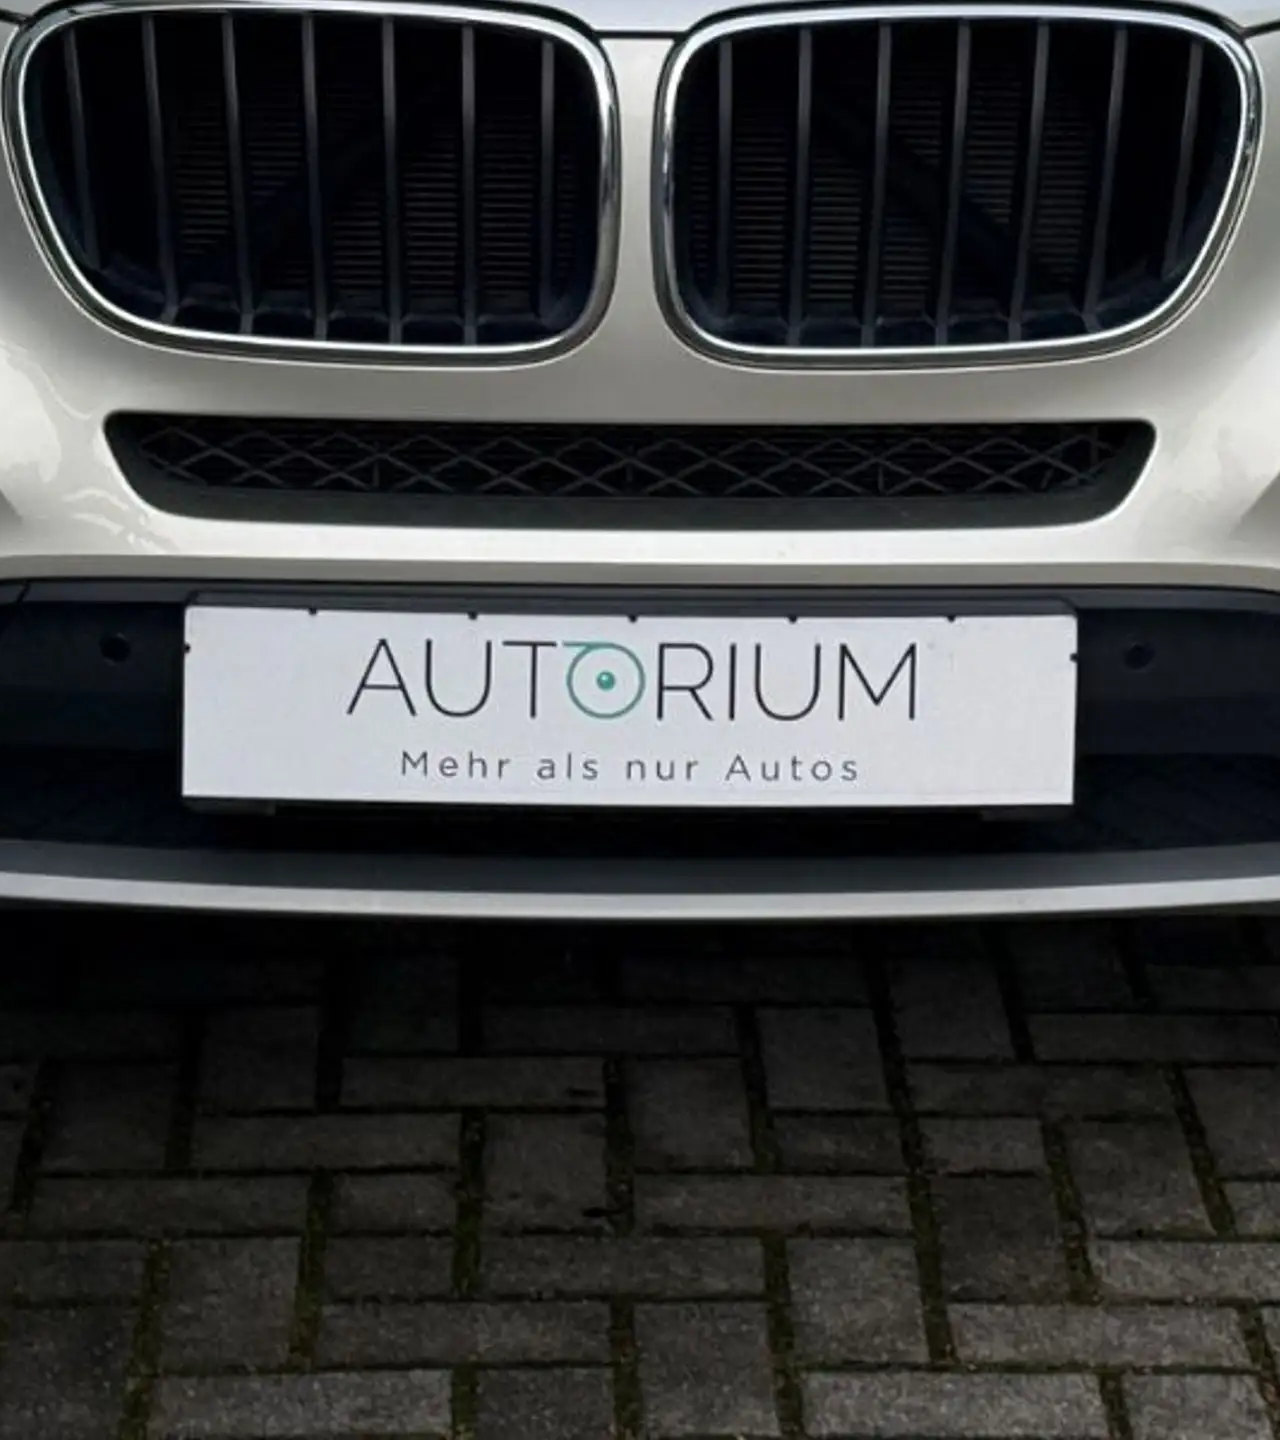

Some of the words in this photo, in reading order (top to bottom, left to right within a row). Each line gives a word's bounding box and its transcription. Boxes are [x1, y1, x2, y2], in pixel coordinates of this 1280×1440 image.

[347, 638, 917, 721] AUTORIUM
[401, 751, 510, 778] Mehr
[536, 753, 599, 781] als
[626, 758, 699, 782] nur
[725, 754, 859, 783] Autos
